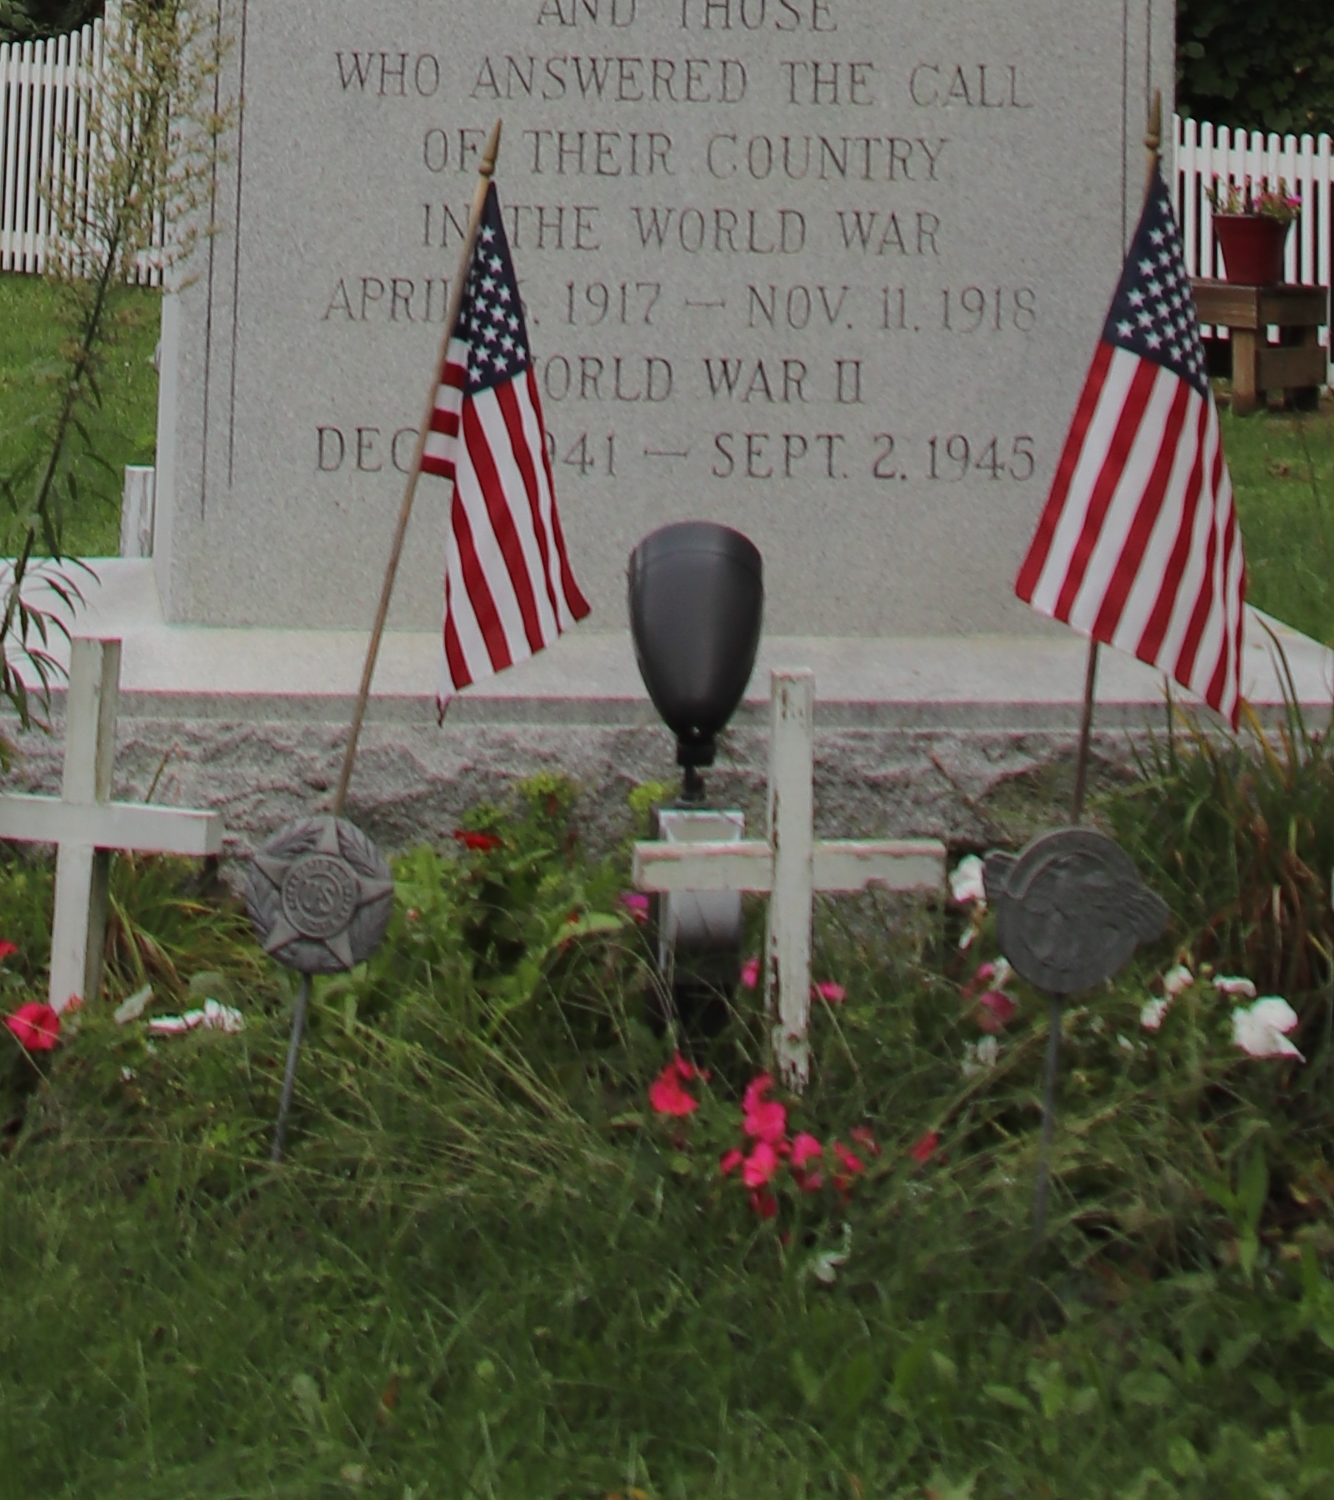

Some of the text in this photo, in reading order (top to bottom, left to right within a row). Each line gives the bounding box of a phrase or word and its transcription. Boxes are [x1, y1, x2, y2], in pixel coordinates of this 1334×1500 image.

[334, 52, 1035, 109] WHO ANSWERED THE CALL
[423, 128, 949, 182] OF THEIR COUNTRY
[422, 203, 941, 256] IN THE WORLD WAR
[566, 280, 662, 327] 1917
[747, 283, 854, 330] NOV.
[940, 285, 1037, 333] 1918
[531, 355, 865, 404] ORLD WAR II
[712, 432, 848, 480] SEPT.
[927, 433, 1036, 482] 1945
